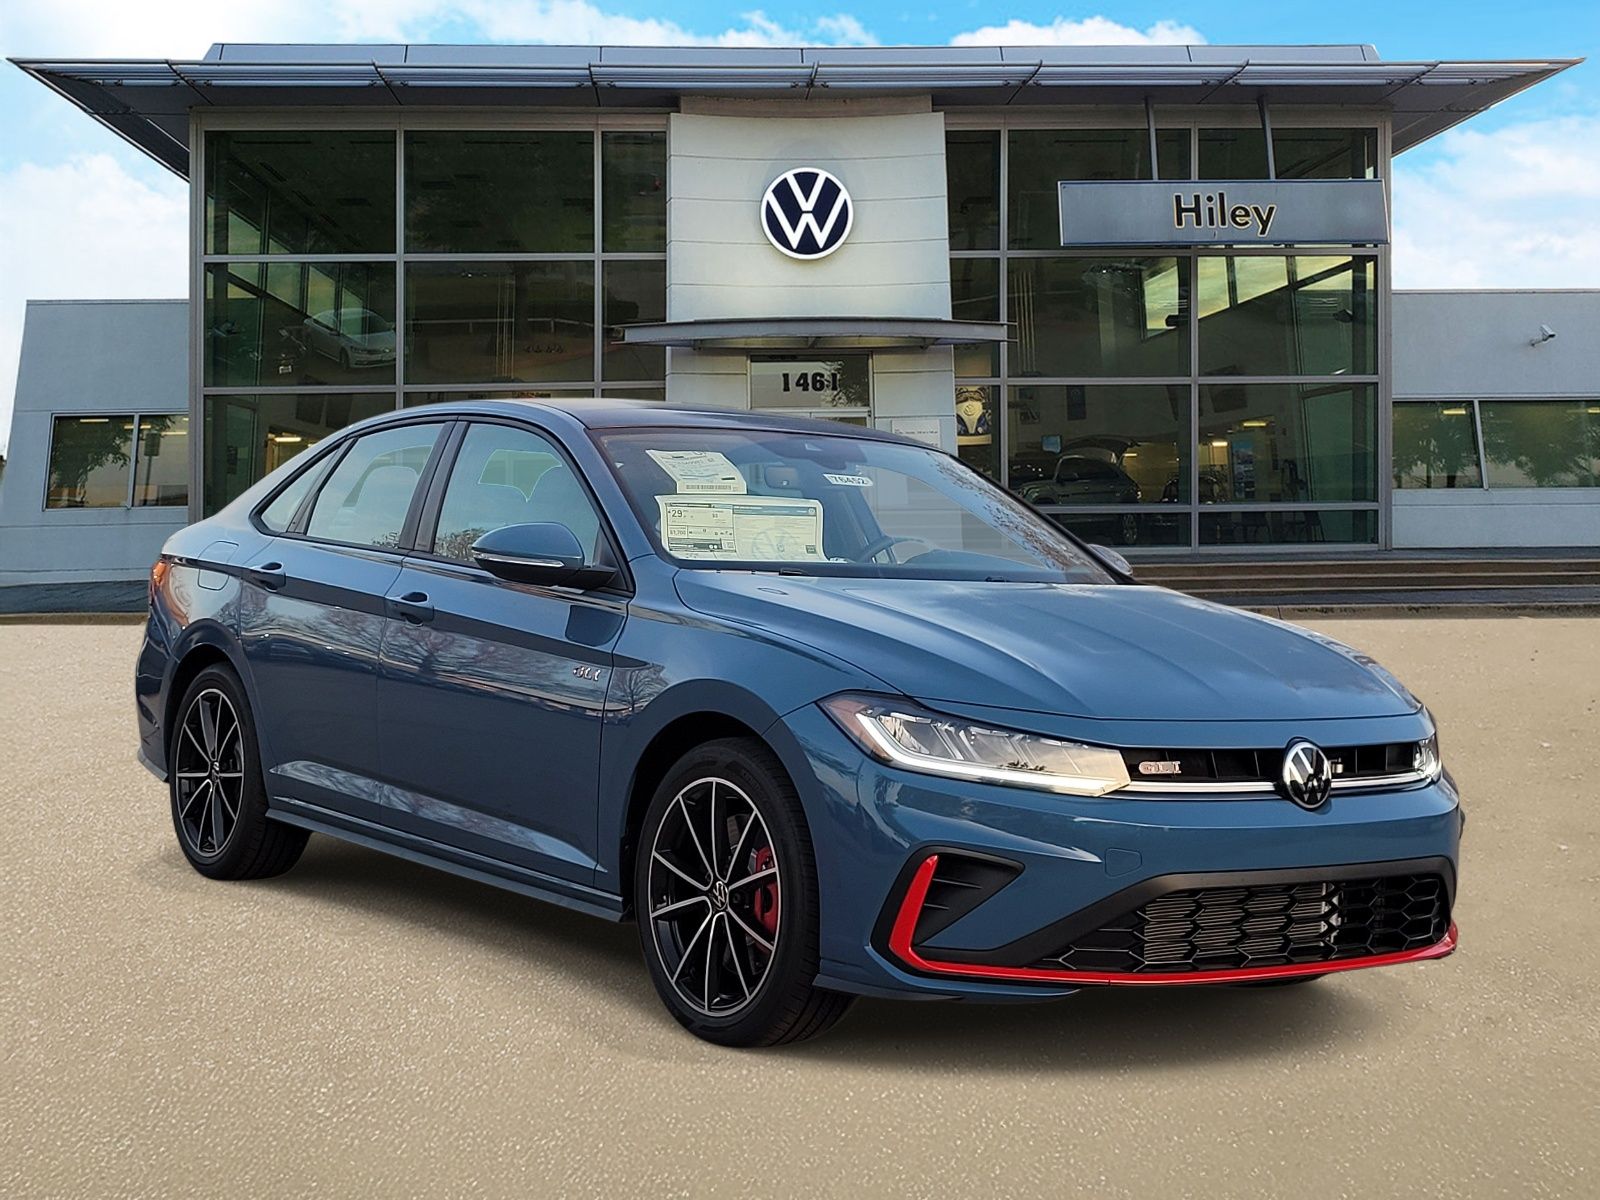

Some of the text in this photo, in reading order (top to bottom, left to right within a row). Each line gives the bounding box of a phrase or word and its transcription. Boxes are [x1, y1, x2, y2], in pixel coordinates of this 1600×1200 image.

[761, 167, 853, 259] VW
[1174, 191, 1276, 237] Hiley
[782, 372, 839, 391] 1461
[671, 509, 683, 518] 29
